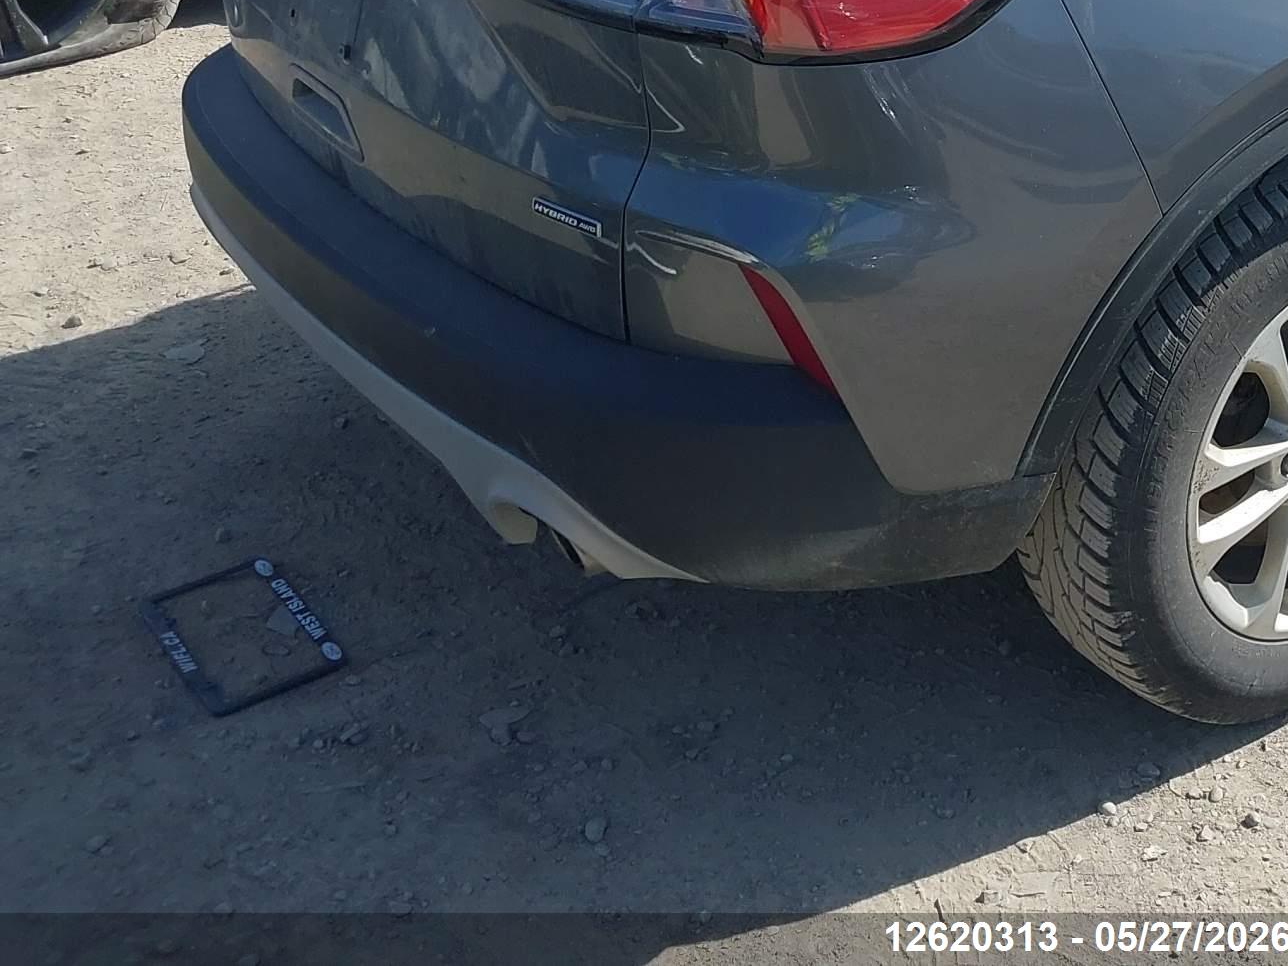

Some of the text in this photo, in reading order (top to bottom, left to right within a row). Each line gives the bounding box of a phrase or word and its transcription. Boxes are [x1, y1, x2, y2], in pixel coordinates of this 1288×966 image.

[534, 202, 578, 227] HYBRID
[271, 578, 328, 641] WEST ISLAND
